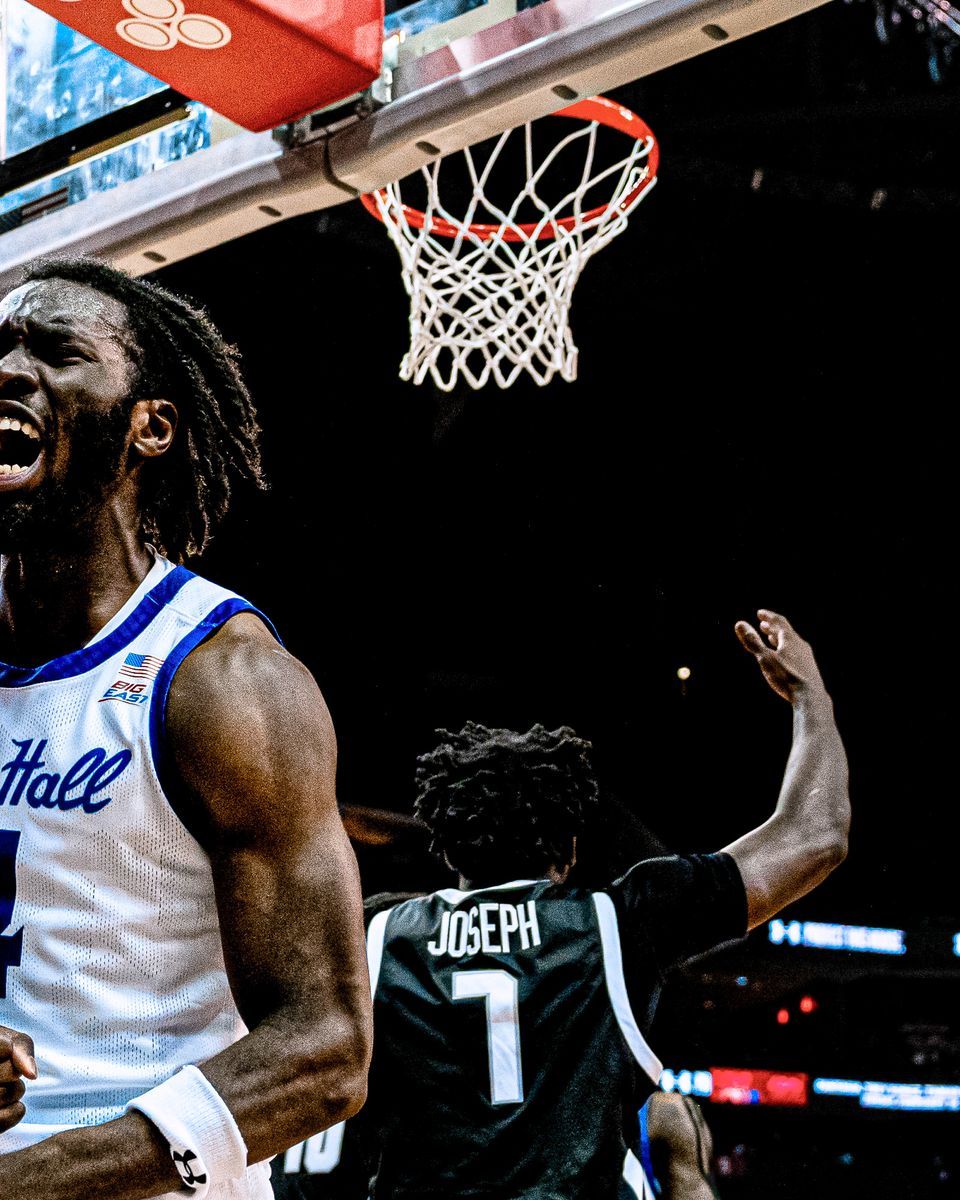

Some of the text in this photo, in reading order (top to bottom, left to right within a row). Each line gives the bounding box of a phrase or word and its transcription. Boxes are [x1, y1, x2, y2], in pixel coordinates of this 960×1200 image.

[103, 688, 149, 704] EAST
[111, 680, 147, 694] BIG
[427, 900, 541, 958] JOSEPH
[452, 969, 524, 1106] 7
